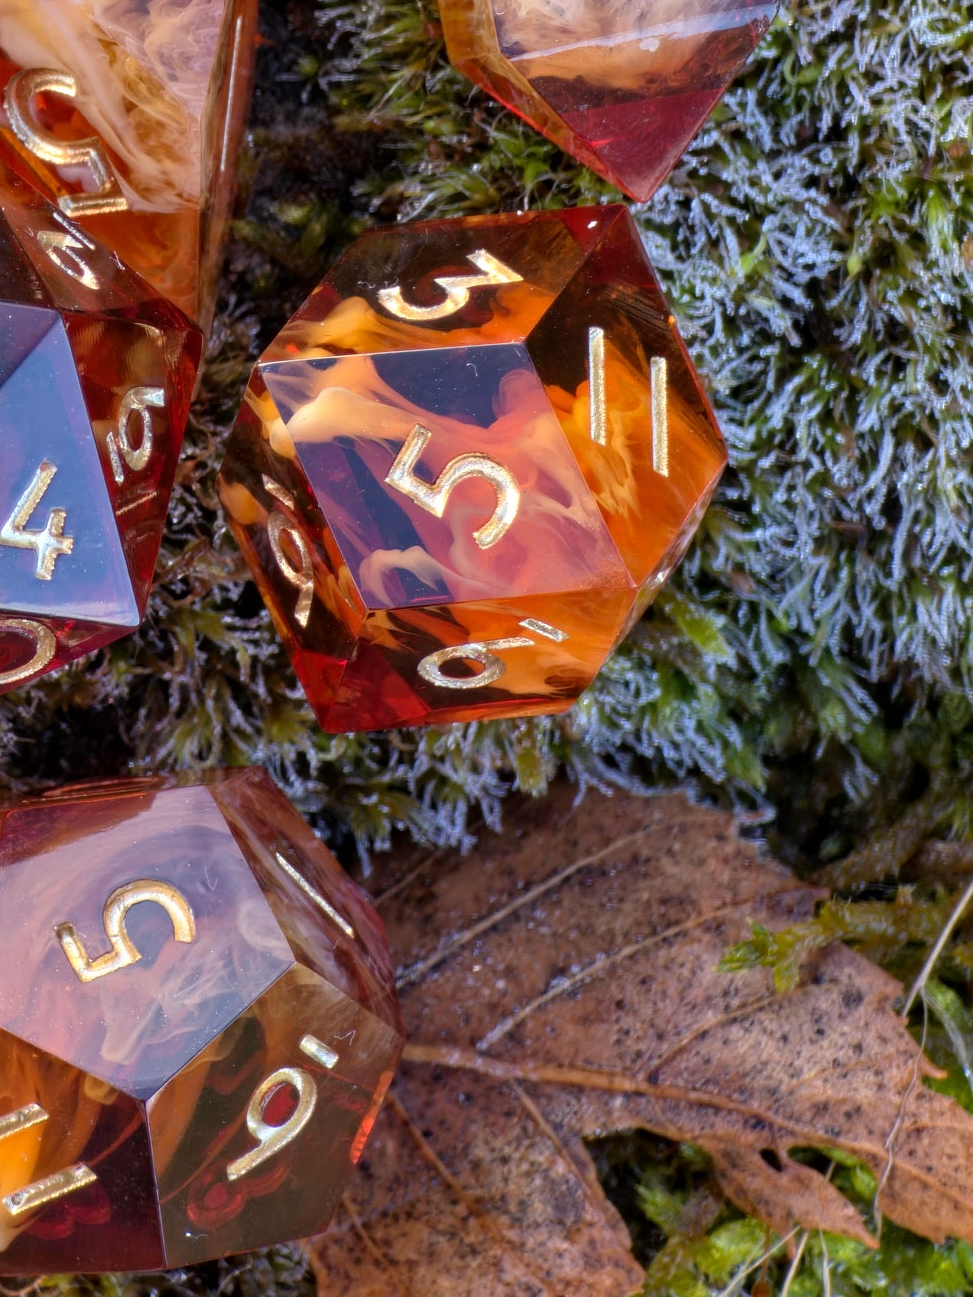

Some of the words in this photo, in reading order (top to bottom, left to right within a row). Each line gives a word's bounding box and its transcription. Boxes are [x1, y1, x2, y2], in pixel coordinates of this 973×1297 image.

[3, 67, 128, 218] 5
[378, 248, 524, 321] 3
[588, 326, 670, 478] 11
[383, 423, 521, 550] 5
[54, 878, 196, 983] 5
